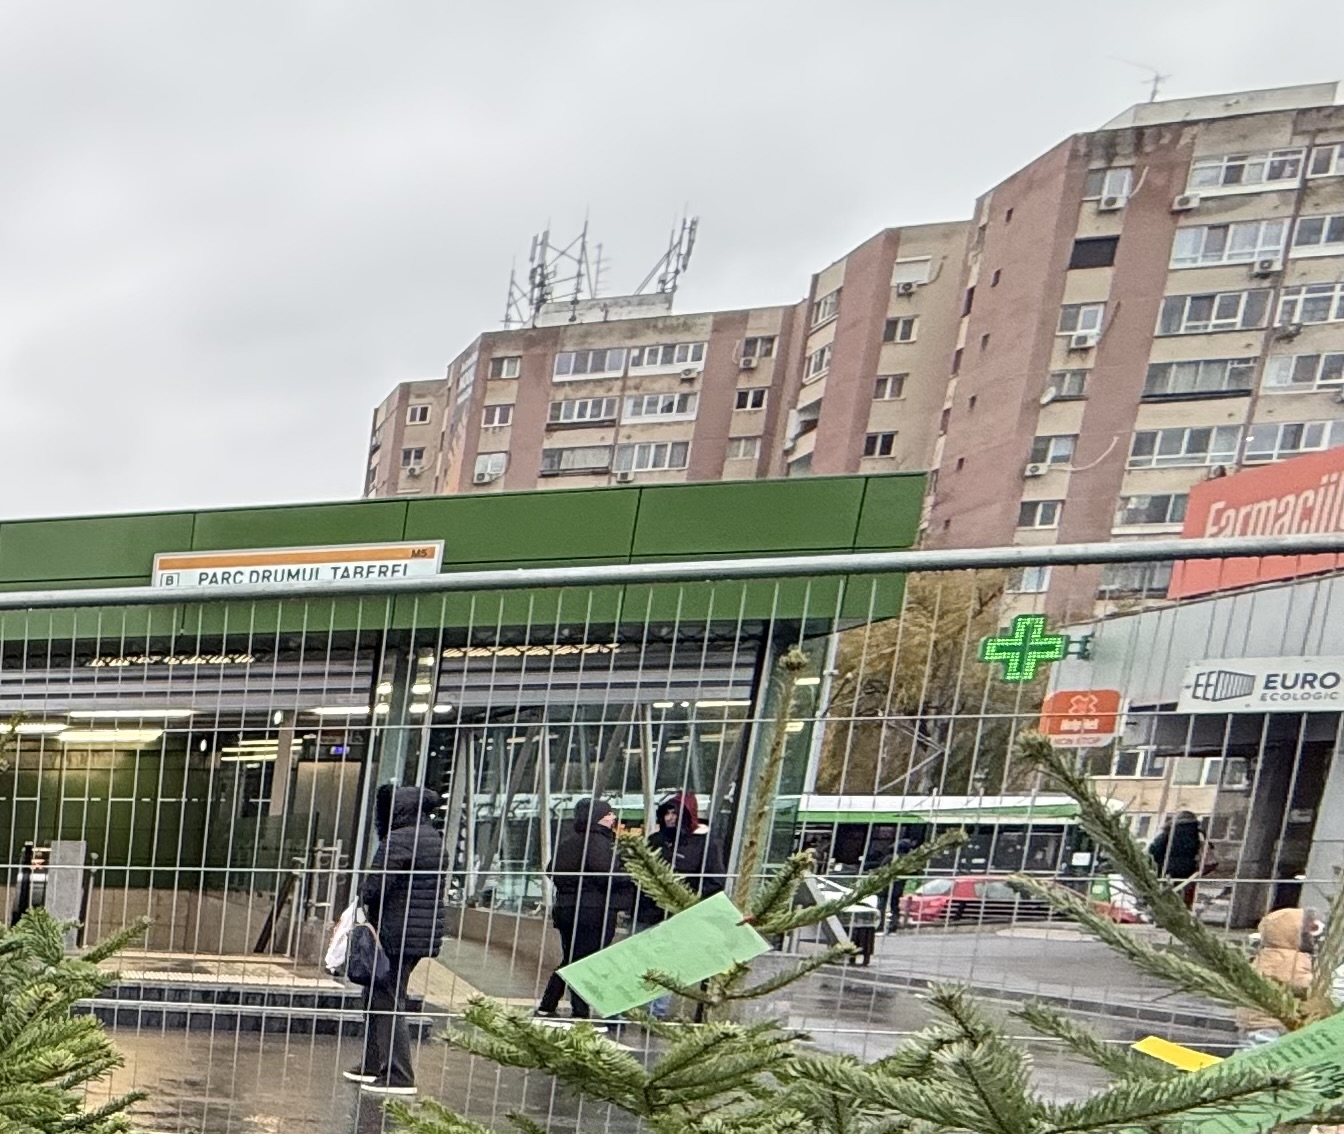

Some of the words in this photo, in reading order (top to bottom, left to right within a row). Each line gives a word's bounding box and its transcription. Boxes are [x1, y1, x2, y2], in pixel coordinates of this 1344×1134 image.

[411, 549, 427, 558] M5
[165, 575, 174, 586] B
[198, 570, 244, 585] PARC
[1264, 672, 1341, 690] EURO
[1260, 691, 1340, 702] ECOLOGIC
